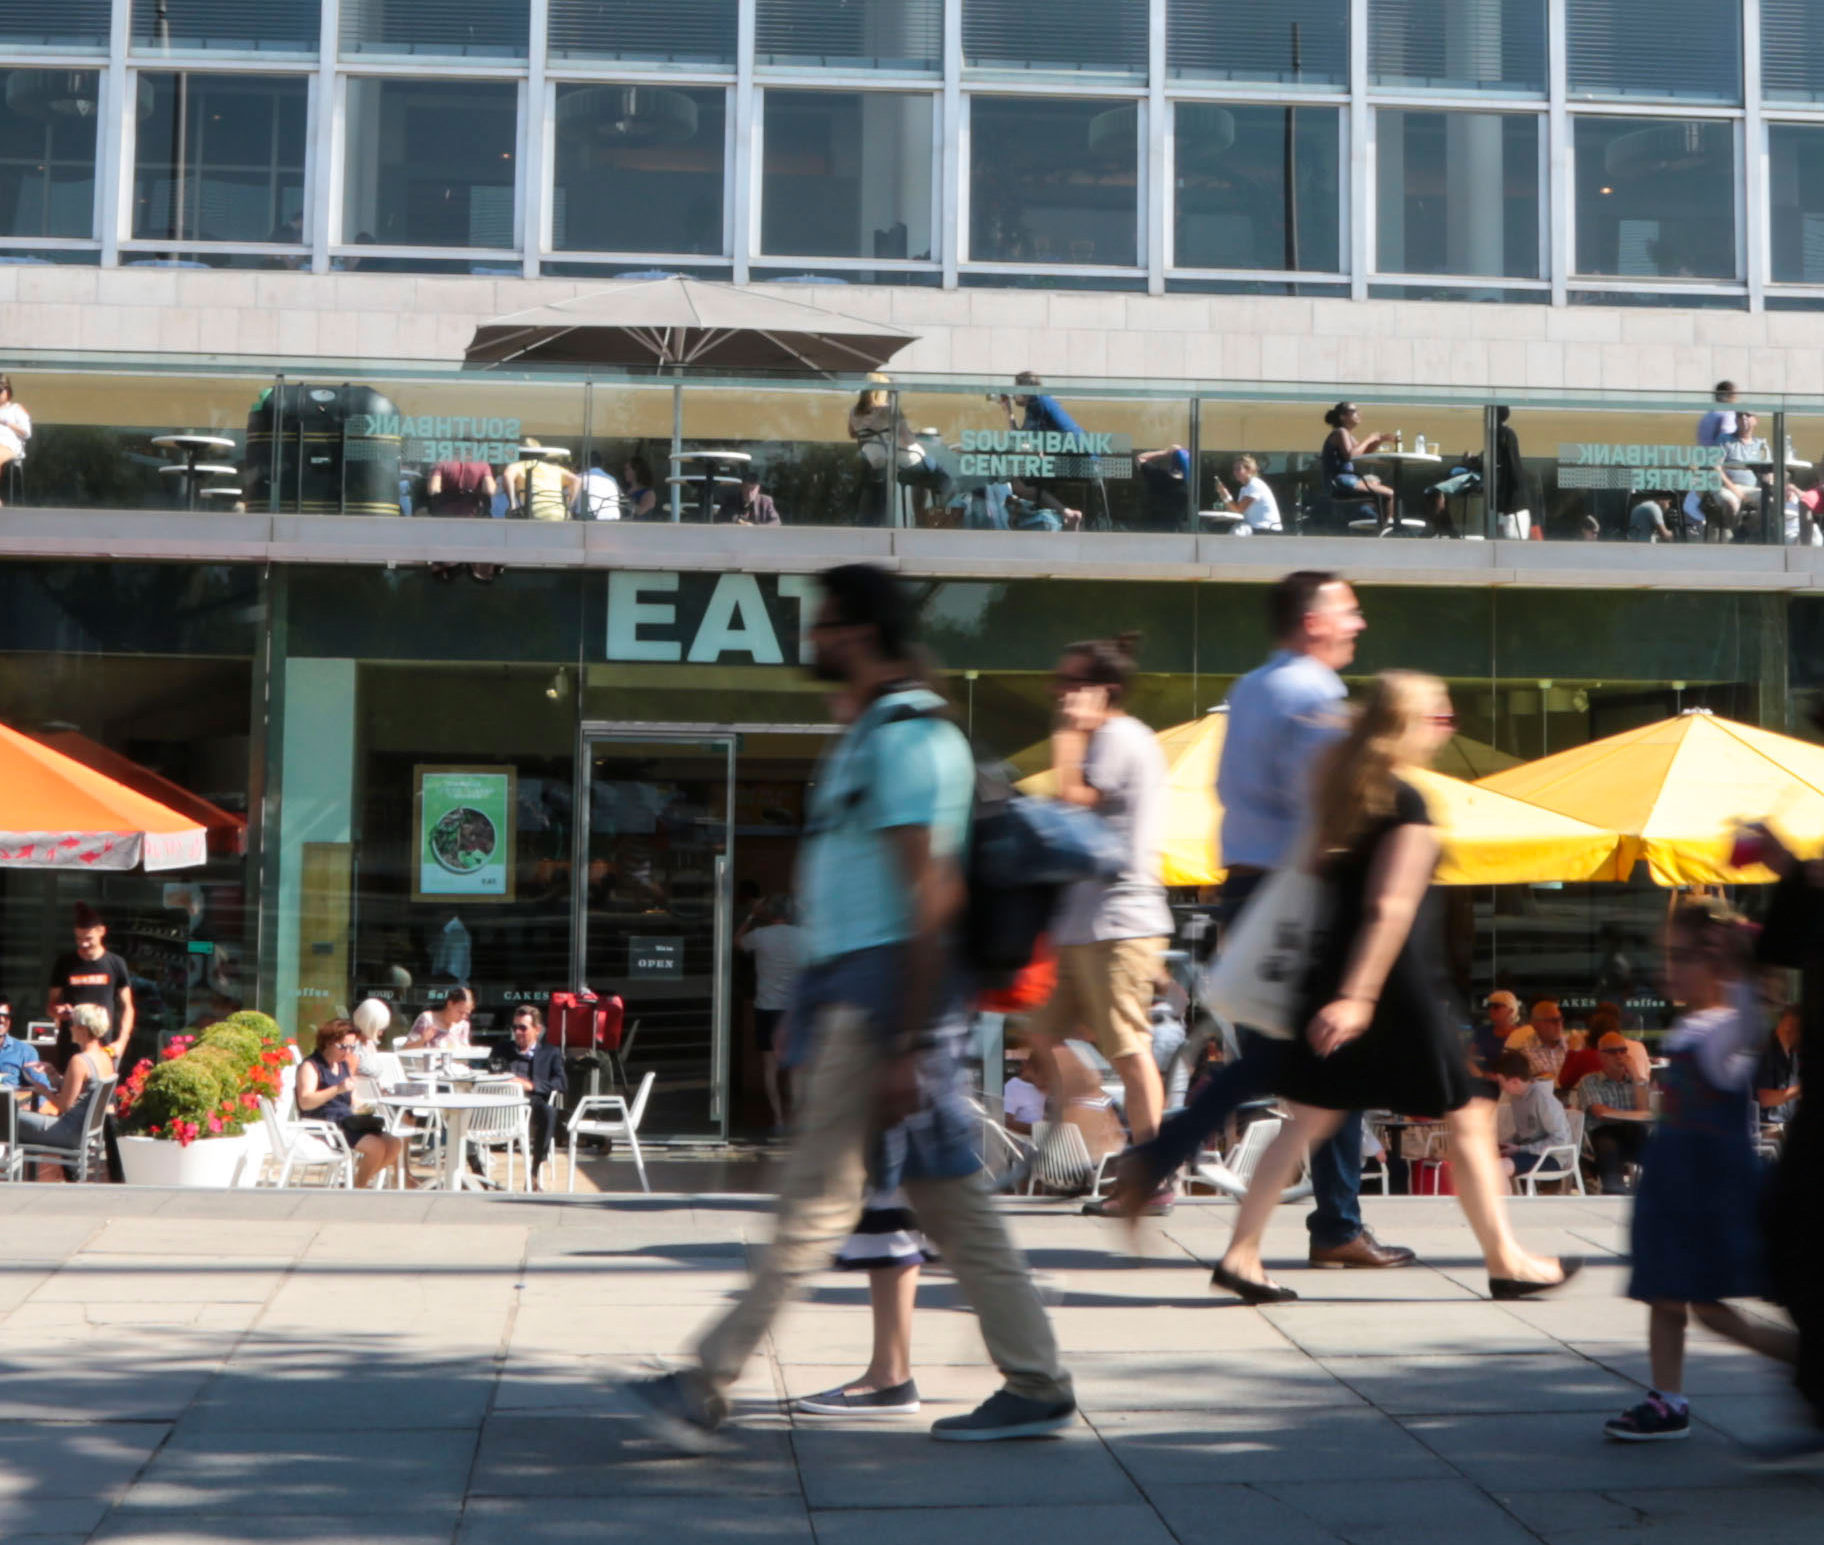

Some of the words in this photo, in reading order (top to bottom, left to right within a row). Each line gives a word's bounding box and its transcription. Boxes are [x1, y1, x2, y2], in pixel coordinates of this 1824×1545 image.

[960, 429, 1112, 453] SOUTHBANK
[960, 454, 1055, 477] CENTRE
[606, 570, 821, 664] EAT
[638, 959, 673, 968] OPEN
[504, 991, 550, 1001] CAKES
[1626, 998, 1665, 1008] coffee
